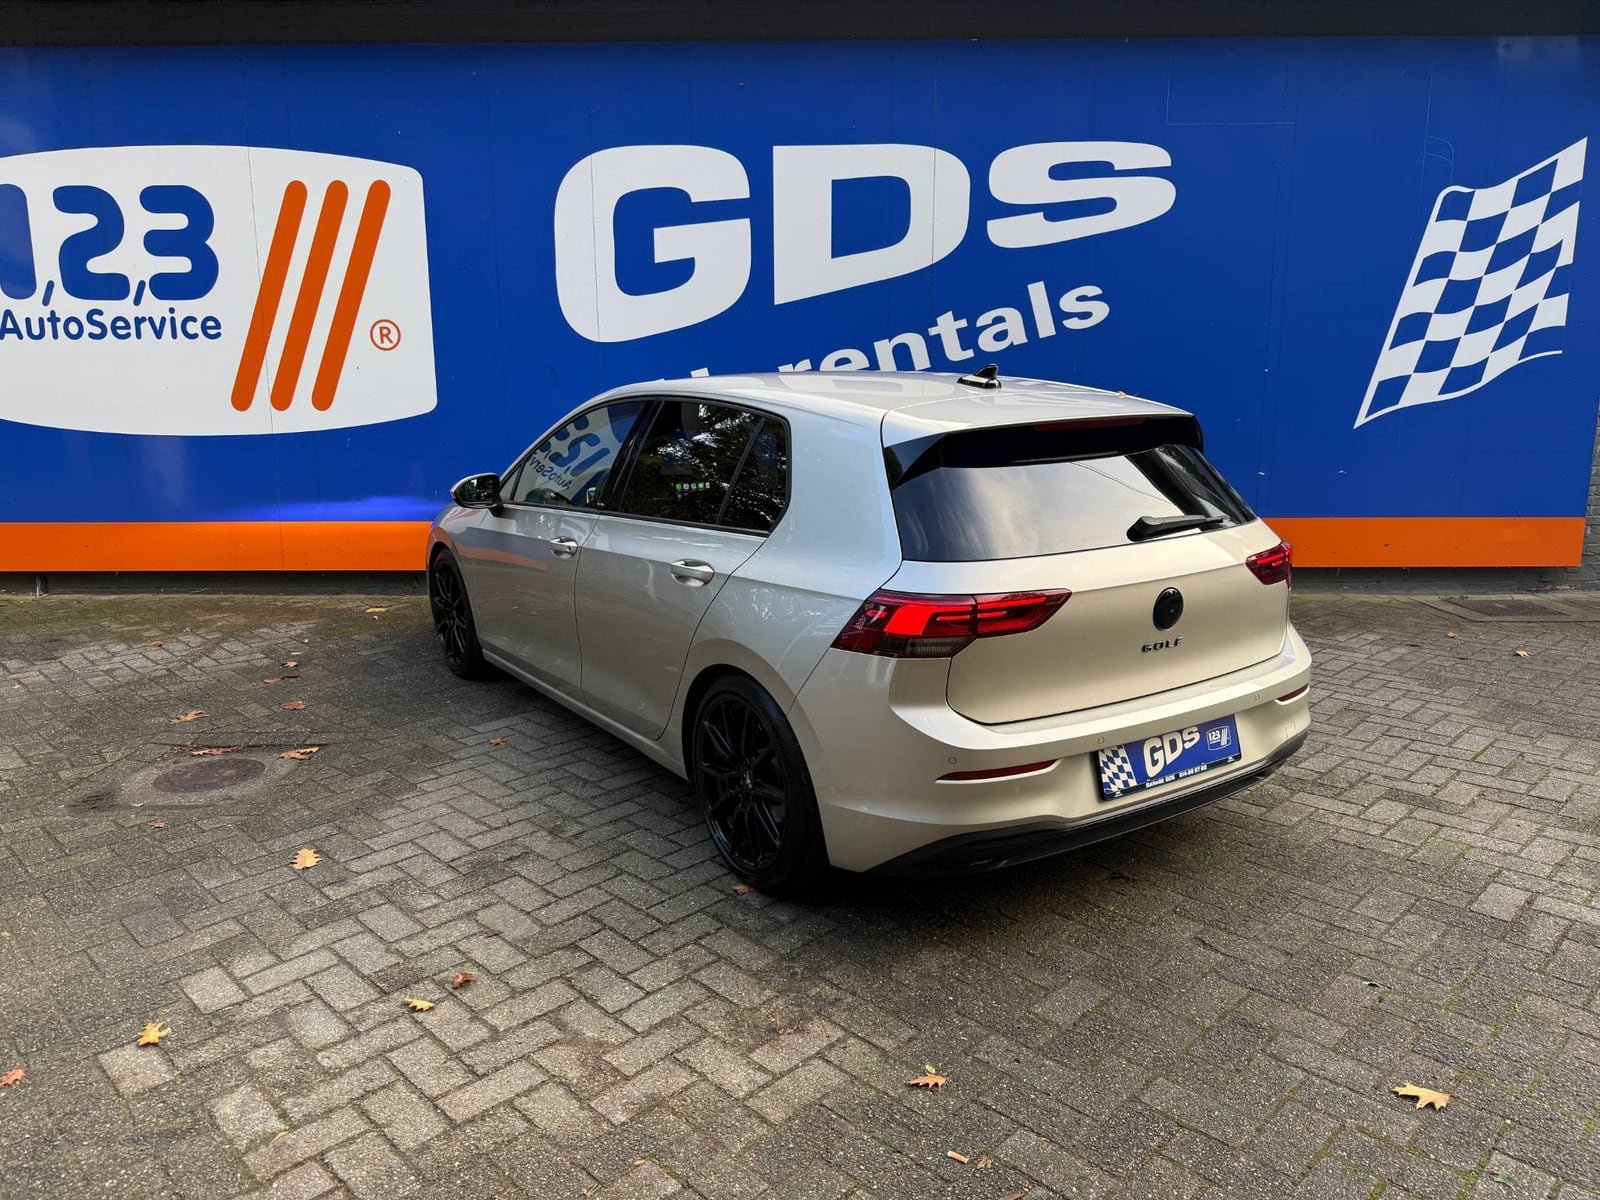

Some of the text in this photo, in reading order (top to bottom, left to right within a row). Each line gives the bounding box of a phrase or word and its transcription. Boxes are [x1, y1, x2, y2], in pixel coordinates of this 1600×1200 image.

[554, 141, 1177, 343] GDS
[0, 307, 222, 341] AutoService
[1142, 637, 1184, 653] GOLF
[1143, 726, 1200, 778] GDS
